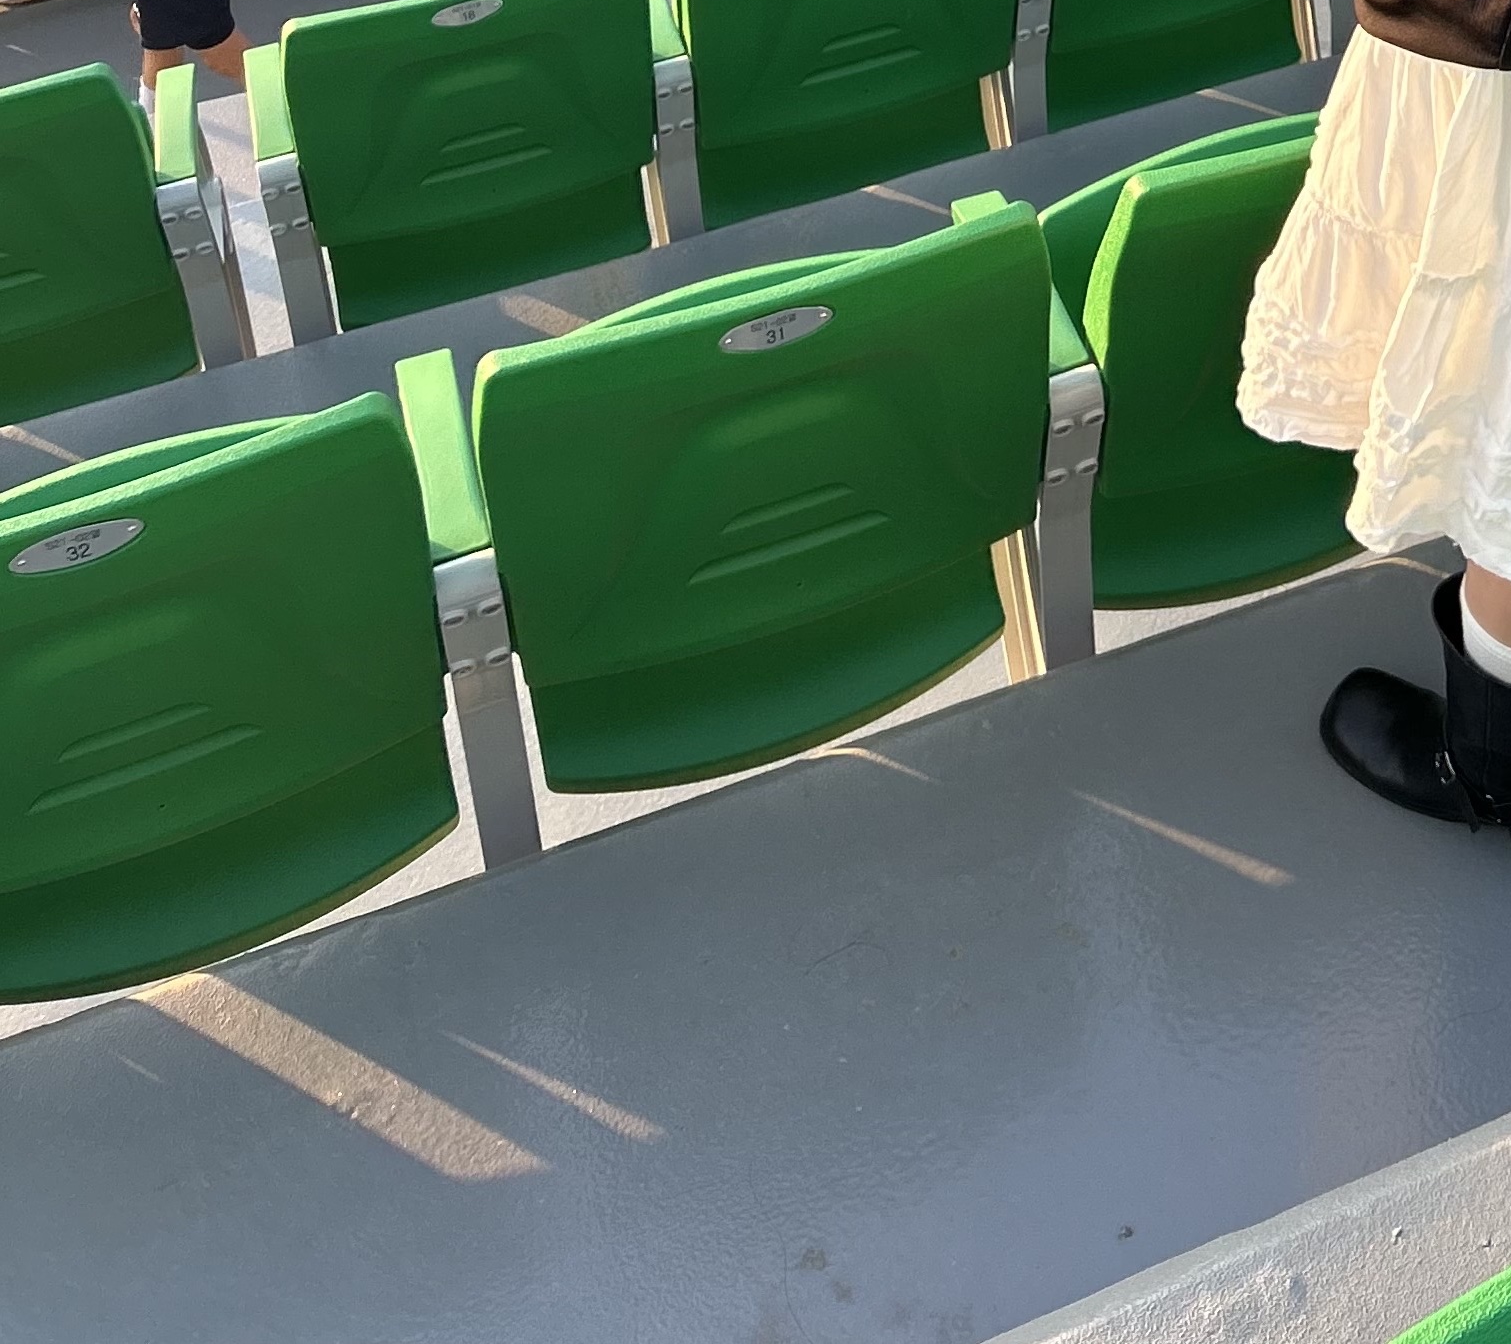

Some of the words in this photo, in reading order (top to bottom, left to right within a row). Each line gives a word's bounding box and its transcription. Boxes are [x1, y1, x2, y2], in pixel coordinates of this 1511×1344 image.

[462, 10, 476, 21] 18
[766, 326, 785, 344] 31
[65, 542, 93, 562] 32
